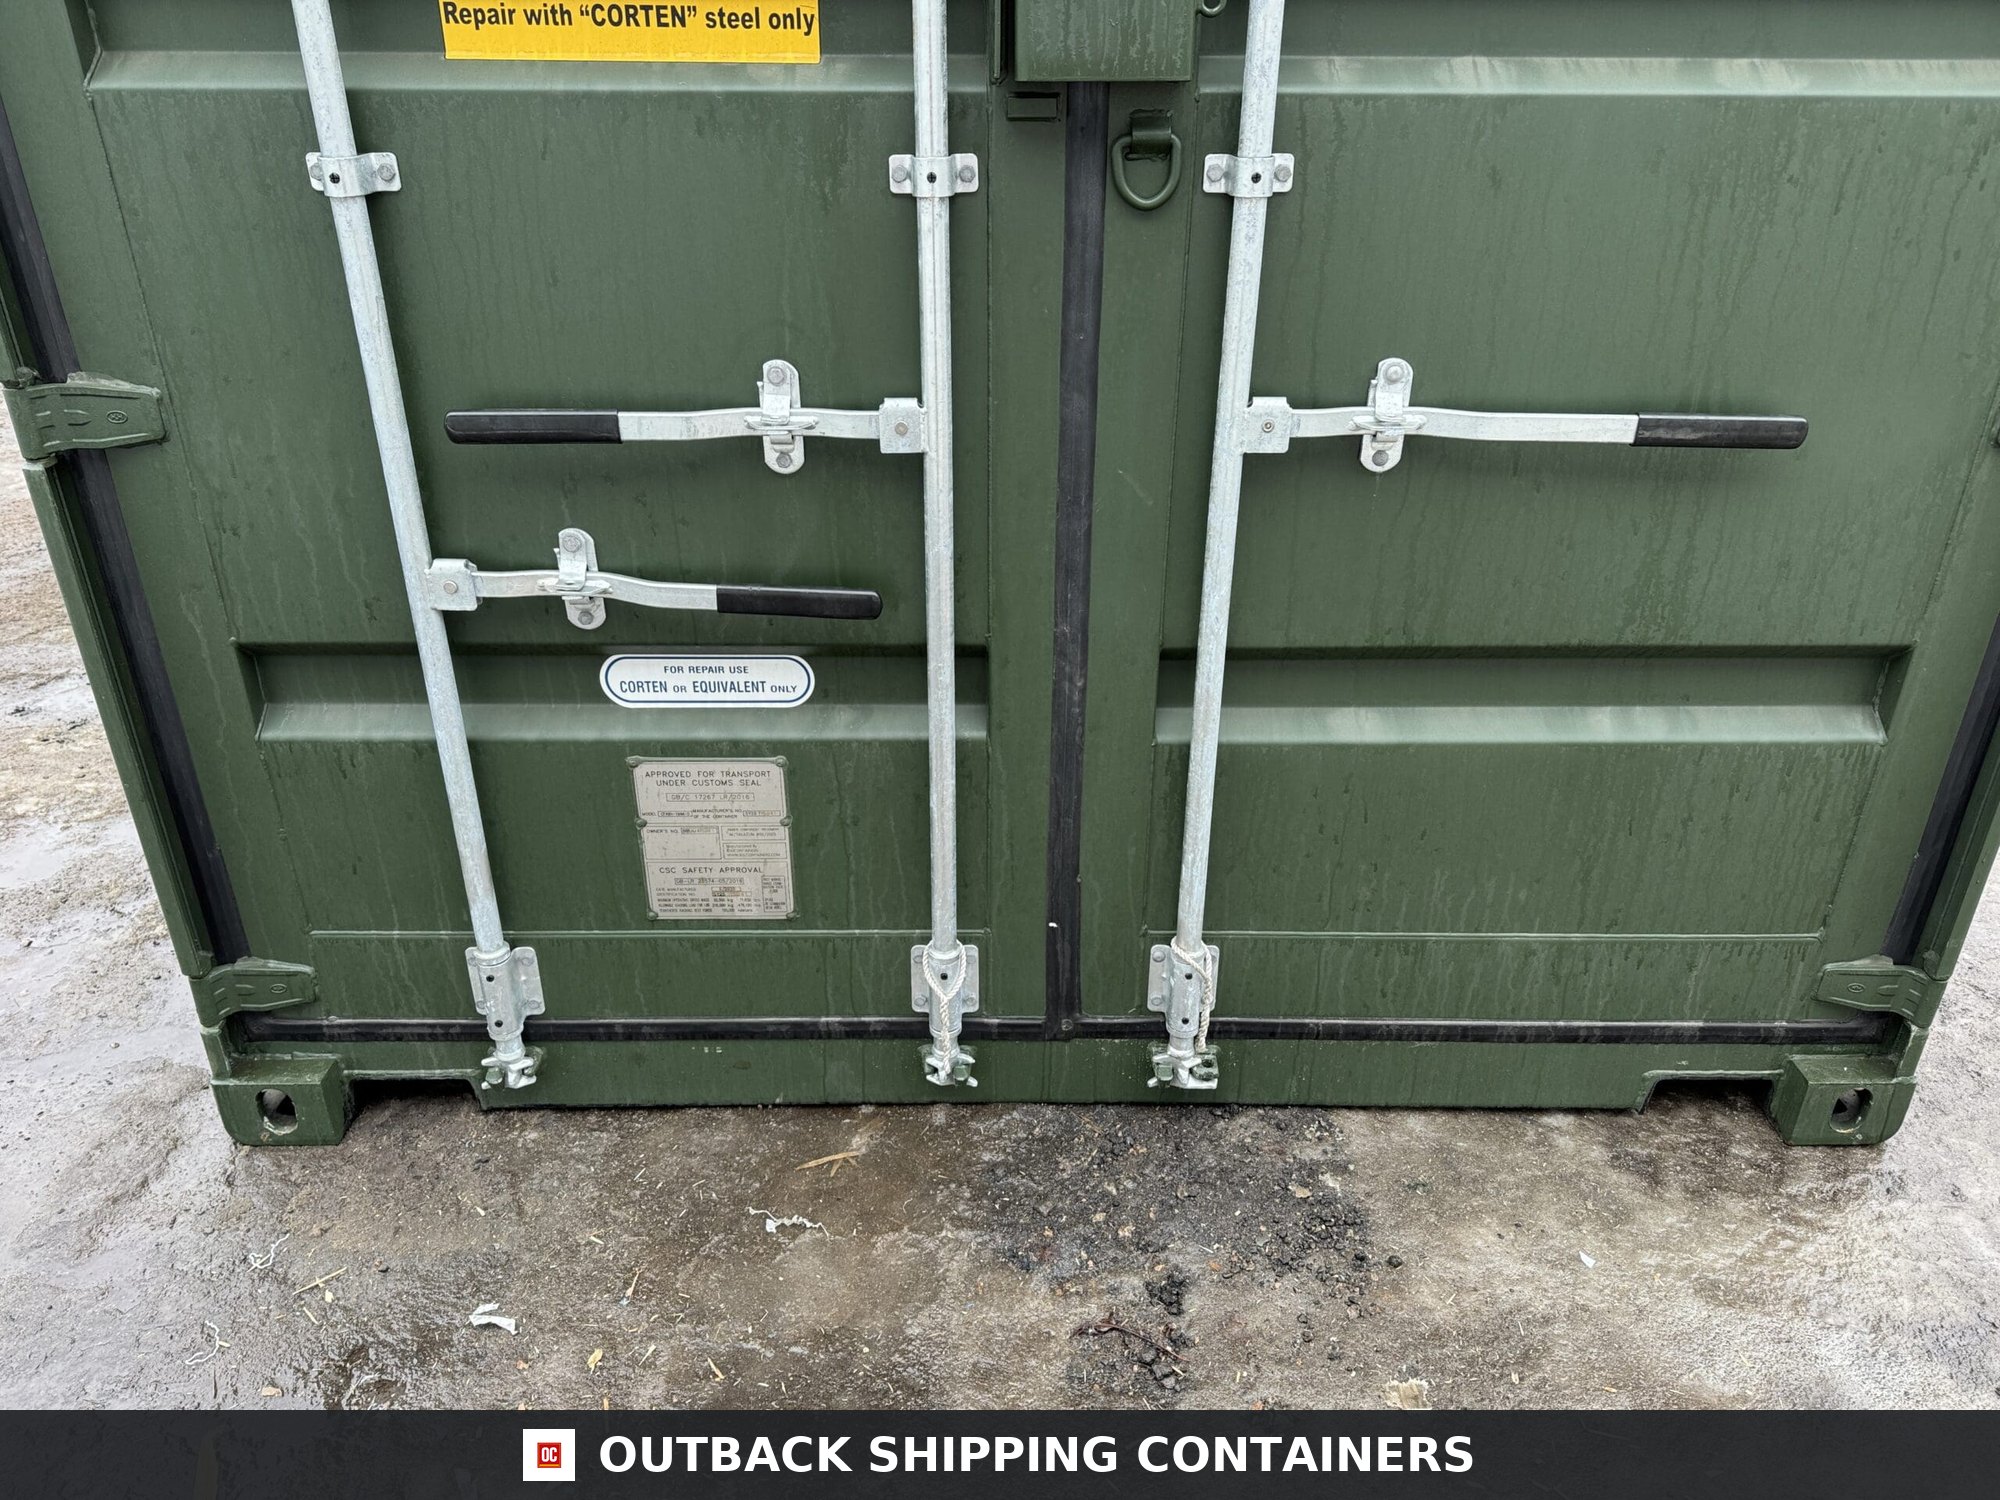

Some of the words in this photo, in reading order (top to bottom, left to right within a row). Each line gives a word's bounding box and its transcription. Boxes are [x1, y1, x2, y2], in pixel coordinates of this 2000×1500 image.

[444, 1, 516, 30] Repair
[522, 4, 573, 26] with
[579, 4, 698, 28] “CORTEN”
[705, 7, 760, 29] steel
[768, 9, 815, 36] only
[663, 665, 684, 674] FOR
[688, 665, 725, 674] REPAIR
[729, 665, 749, 674] USE
[619, 680, 668, 693] CORTEN
[673, 685, 687, 693] OR
[693, 680, 766, 693] EQUIVALENT
[770, 685, 797, 693] ONLY
[645, 770, 691, 778] APPROVED
[697, 770, 714, 778] FOR
[721, 770, 771, 778] TRANSPORT
